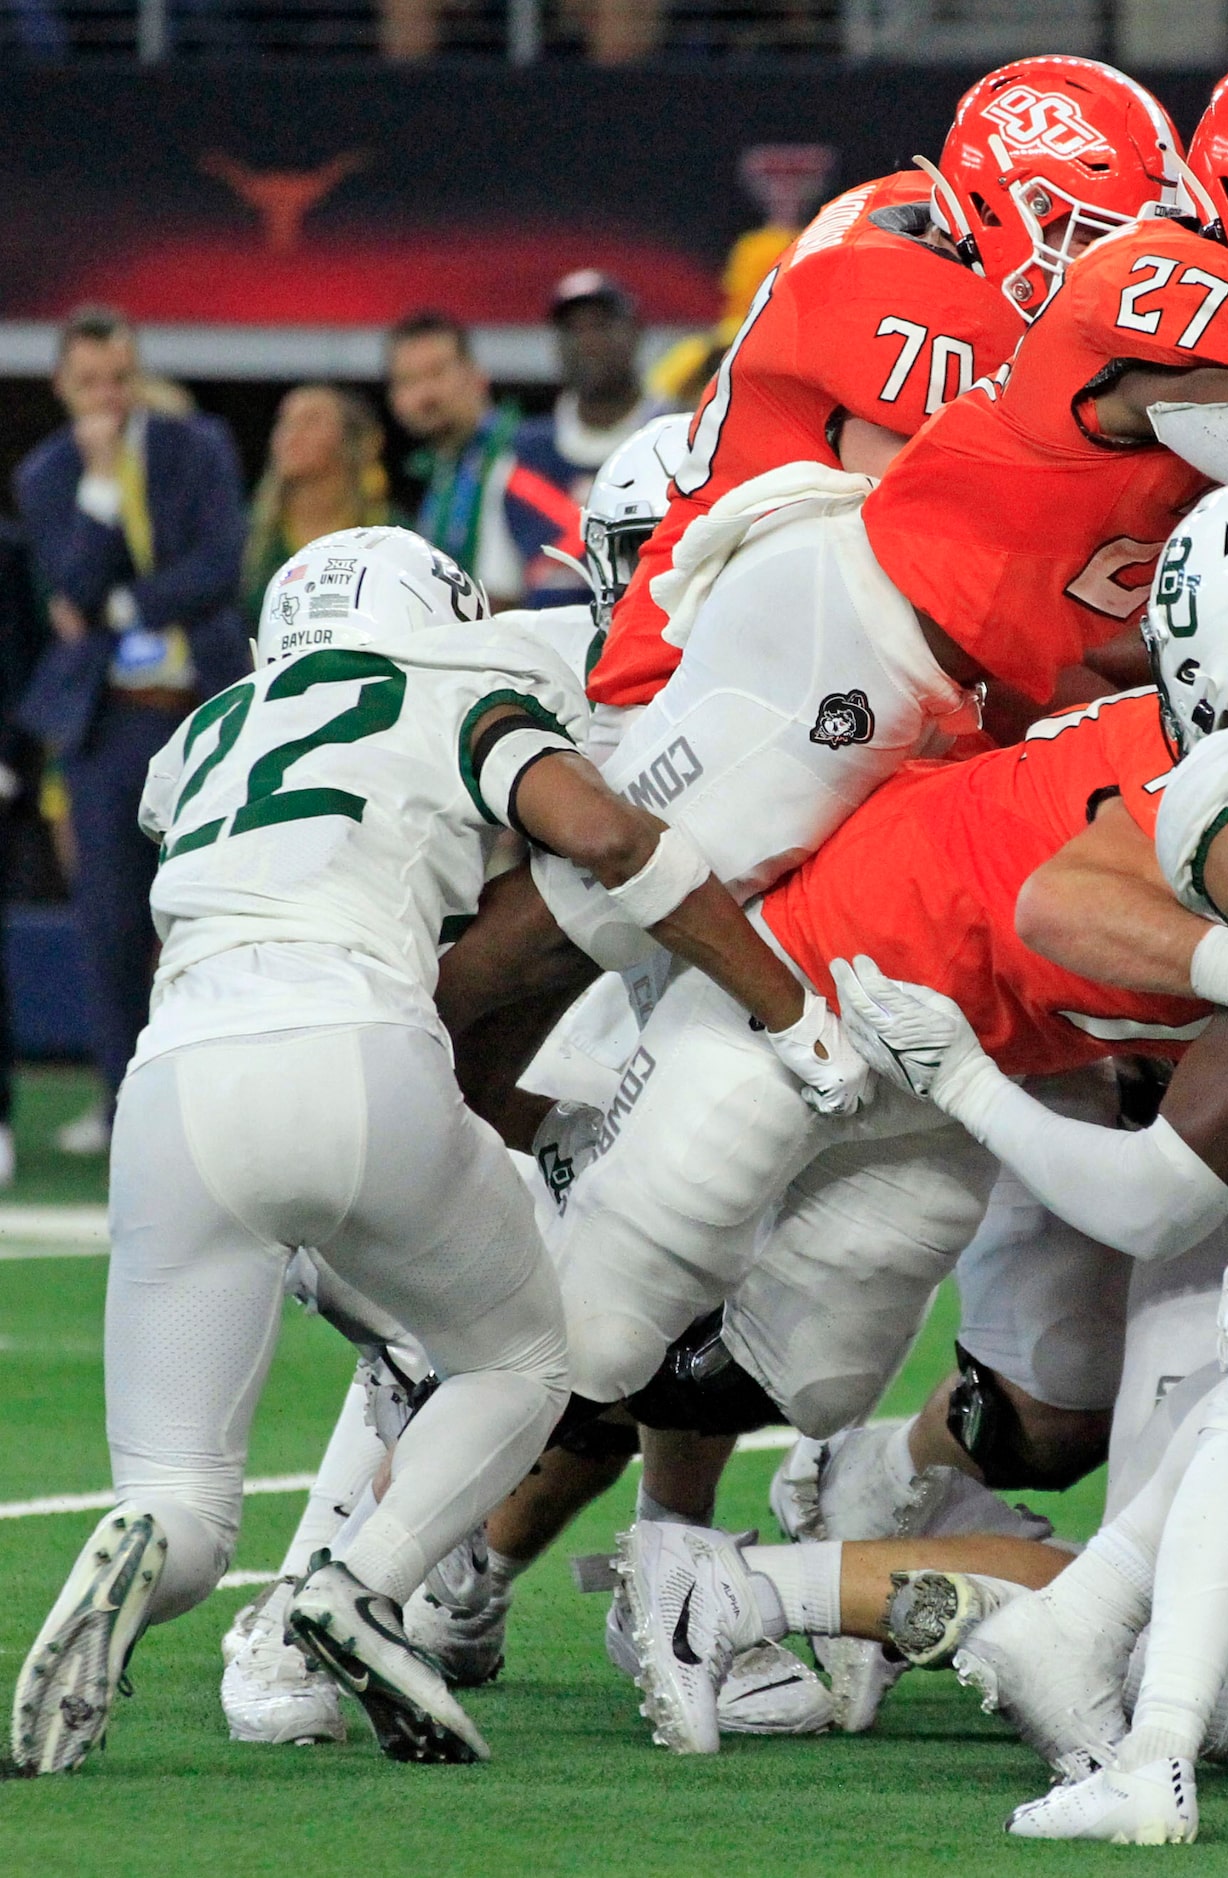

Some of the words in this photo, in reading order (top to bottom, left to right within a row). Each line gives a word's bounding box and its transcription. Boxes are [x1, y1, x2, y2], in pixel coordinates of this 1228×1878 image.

[875, 315, 974, 416] 70
[320, 574, 352, 585] UNITY
[1156, 536, 1201, 638] BU
[281, 629, 333, 650] BAYLOR
[158, 648, 408, 867] 22
[620, 735, 704, 809] COW
